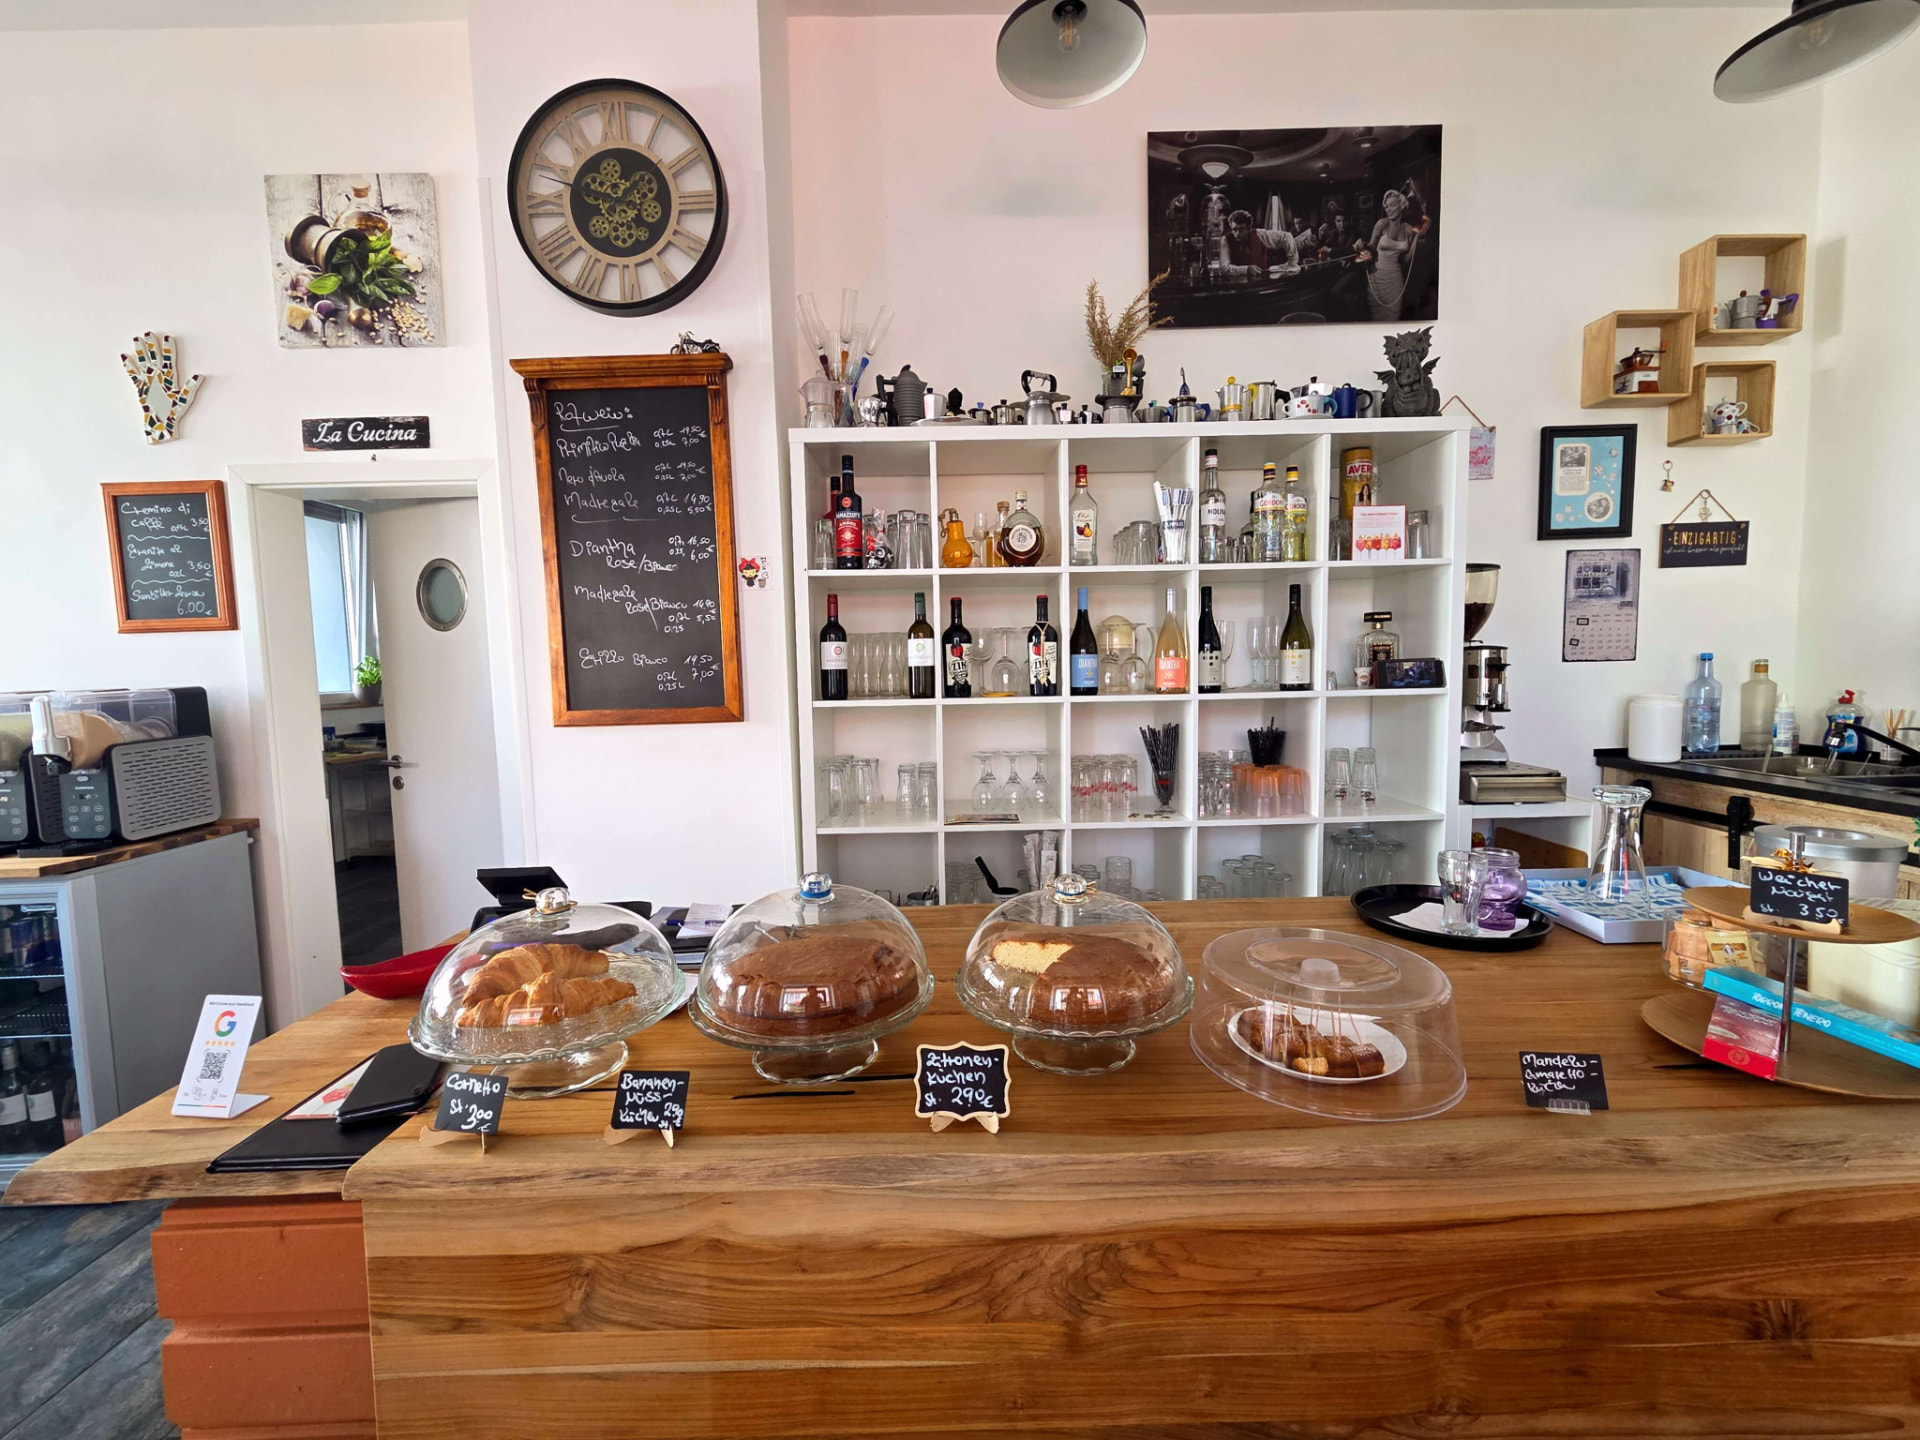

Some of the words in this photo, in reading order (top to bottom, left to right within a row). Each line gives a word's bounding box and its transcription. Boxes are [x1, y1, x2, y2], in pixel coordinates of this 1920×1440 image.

[312, 421, 343, 443] La
[347, 421, 417, 442] Cucina
[1673, 530, 1736, 546] EINZIGARTIG
[447, 1073, 500, 1096] Cornetto
